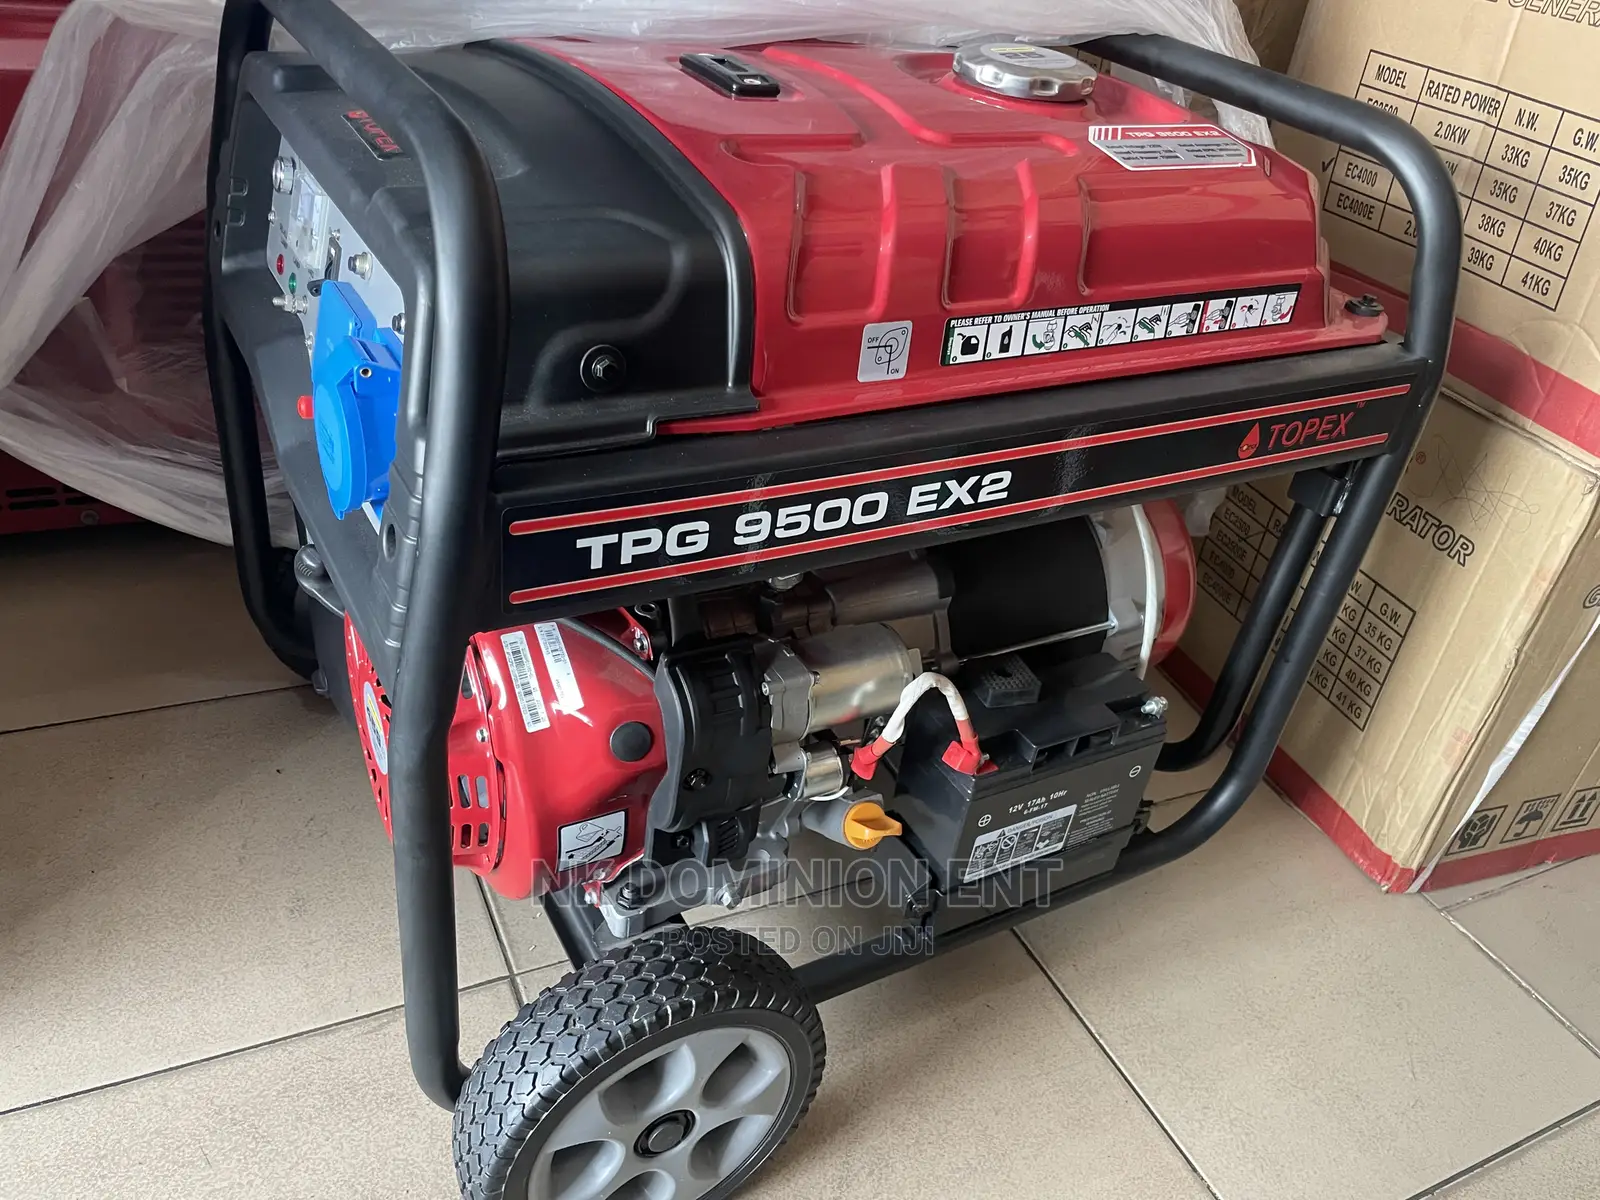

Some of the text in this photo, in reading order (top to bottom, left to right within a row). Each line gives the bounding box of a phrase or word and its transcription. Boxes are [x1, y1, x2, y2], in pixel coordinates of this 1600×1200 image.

[1375, 64, 1599, 152] MODEL RATED POWER N.W. G.W.
[1434, 121, 1590, 190] 2.0KW 33KG 35KG
[1344, 162, 1564, 262] EC4000 38KG 40KG
[1490, 179, 1577, 227] 35KG 37KG
[1336, 192, 1551, 296] EC4000E 39KG 41KG
[950, 304, 1110, 327] PLEASE REFER TO OWNER'S MANUAL BEFORE OPERATION
[868, 336, 880, 344] OFF
[1268, 412, 1355, 450] TOPEX
[576, 470, 1013, 570] TPG 9500 EX2
[1380, 602, 1402, 628] G.W.
[1364, 622, 1378, 638] 35
[1376, 631, 1393, 651] KG
[1354, 645, 1367, 660] 37
[1366, 654, 1382, 674] KG
[1345, 668, 1356, 684] 40
[1356, 678, 1372, 697] KG
[1336, 692, 1348, 706] 41
[1347, 700, 1362, 719] KG
[1008, 790, 1068, 814] 12V 17Ah 10Hr
